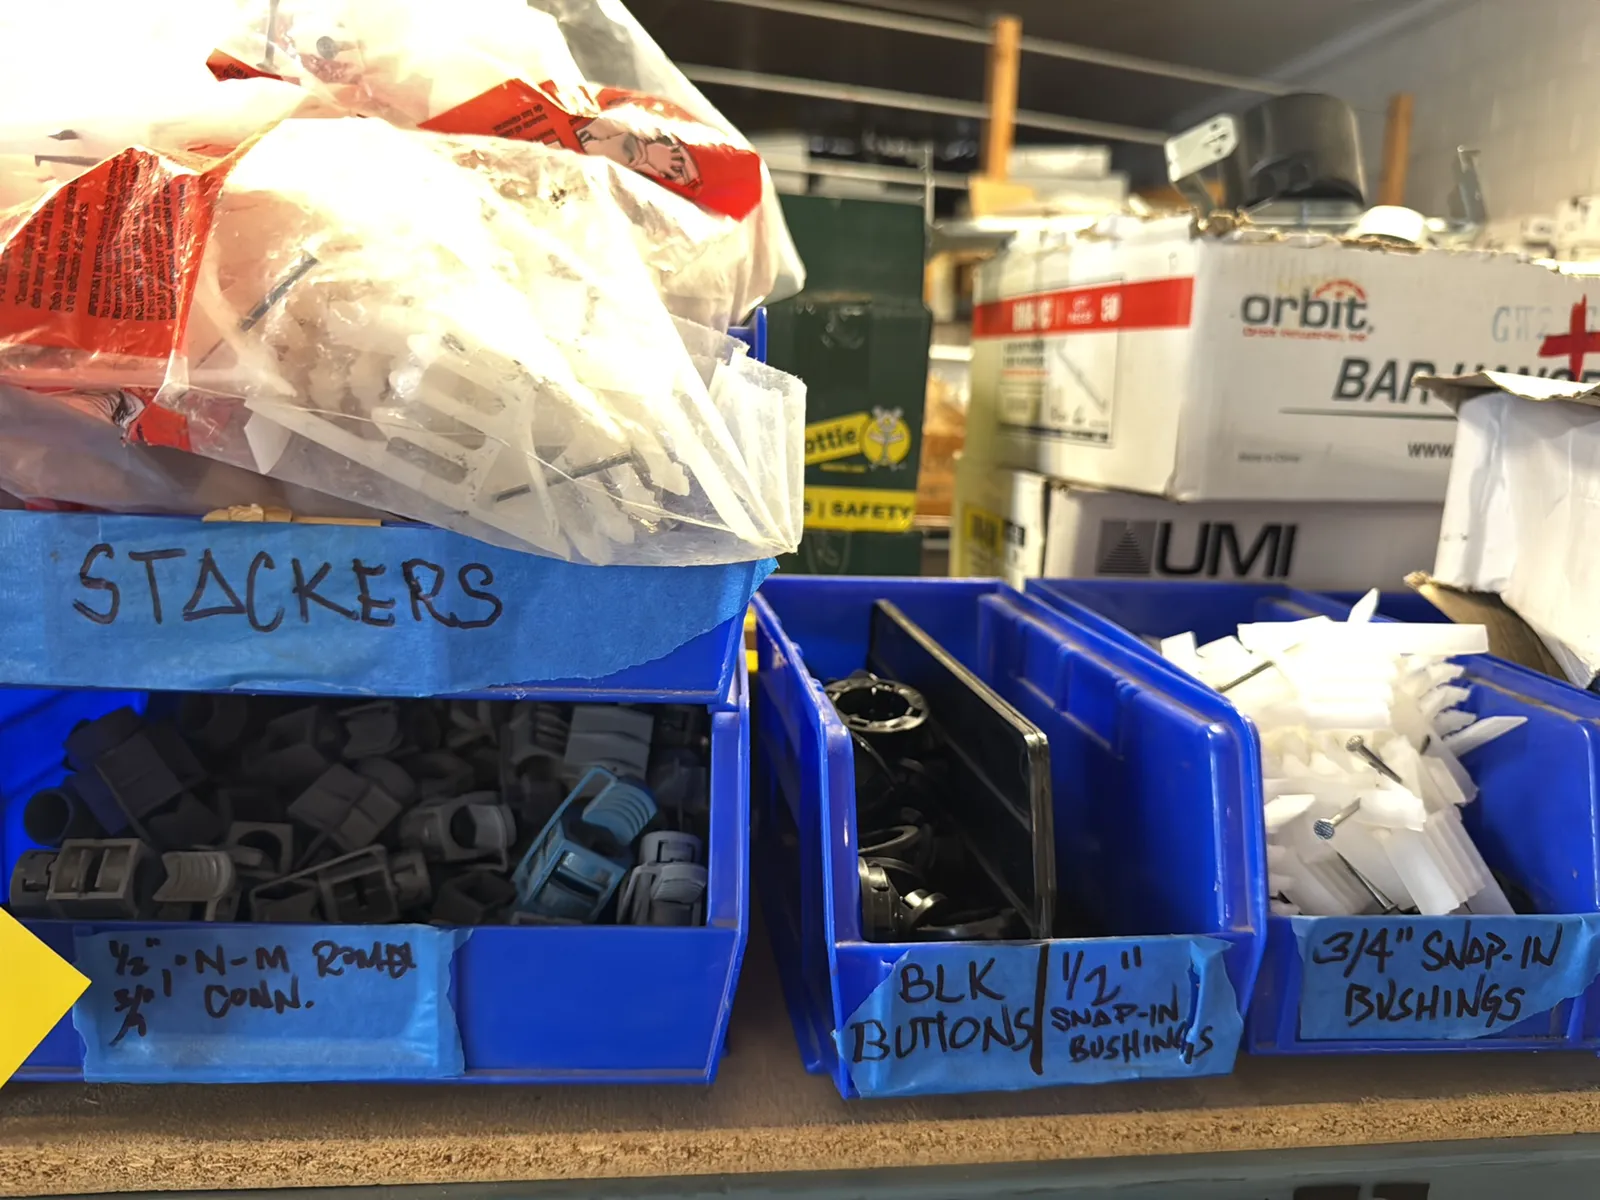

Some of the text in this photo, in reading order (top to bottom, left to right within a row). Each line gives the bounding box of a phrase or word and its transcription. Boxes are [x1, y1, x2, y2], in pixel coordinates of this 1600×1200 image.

[804, 426, 857, 453] ottie
[832, 499, 913, 519] SAFETY
[1155, 520, 1298, 578] UMI
[72, 543, 503, 632] STACKERS
[898, 956, 1006, 1003] BLK
[1344, 973, 1526, 1029] BUSHINGS
[849, 1003, 1034, 1063] BUTTONS
[1050, 982, 1179, 1033] SNAP-IN
